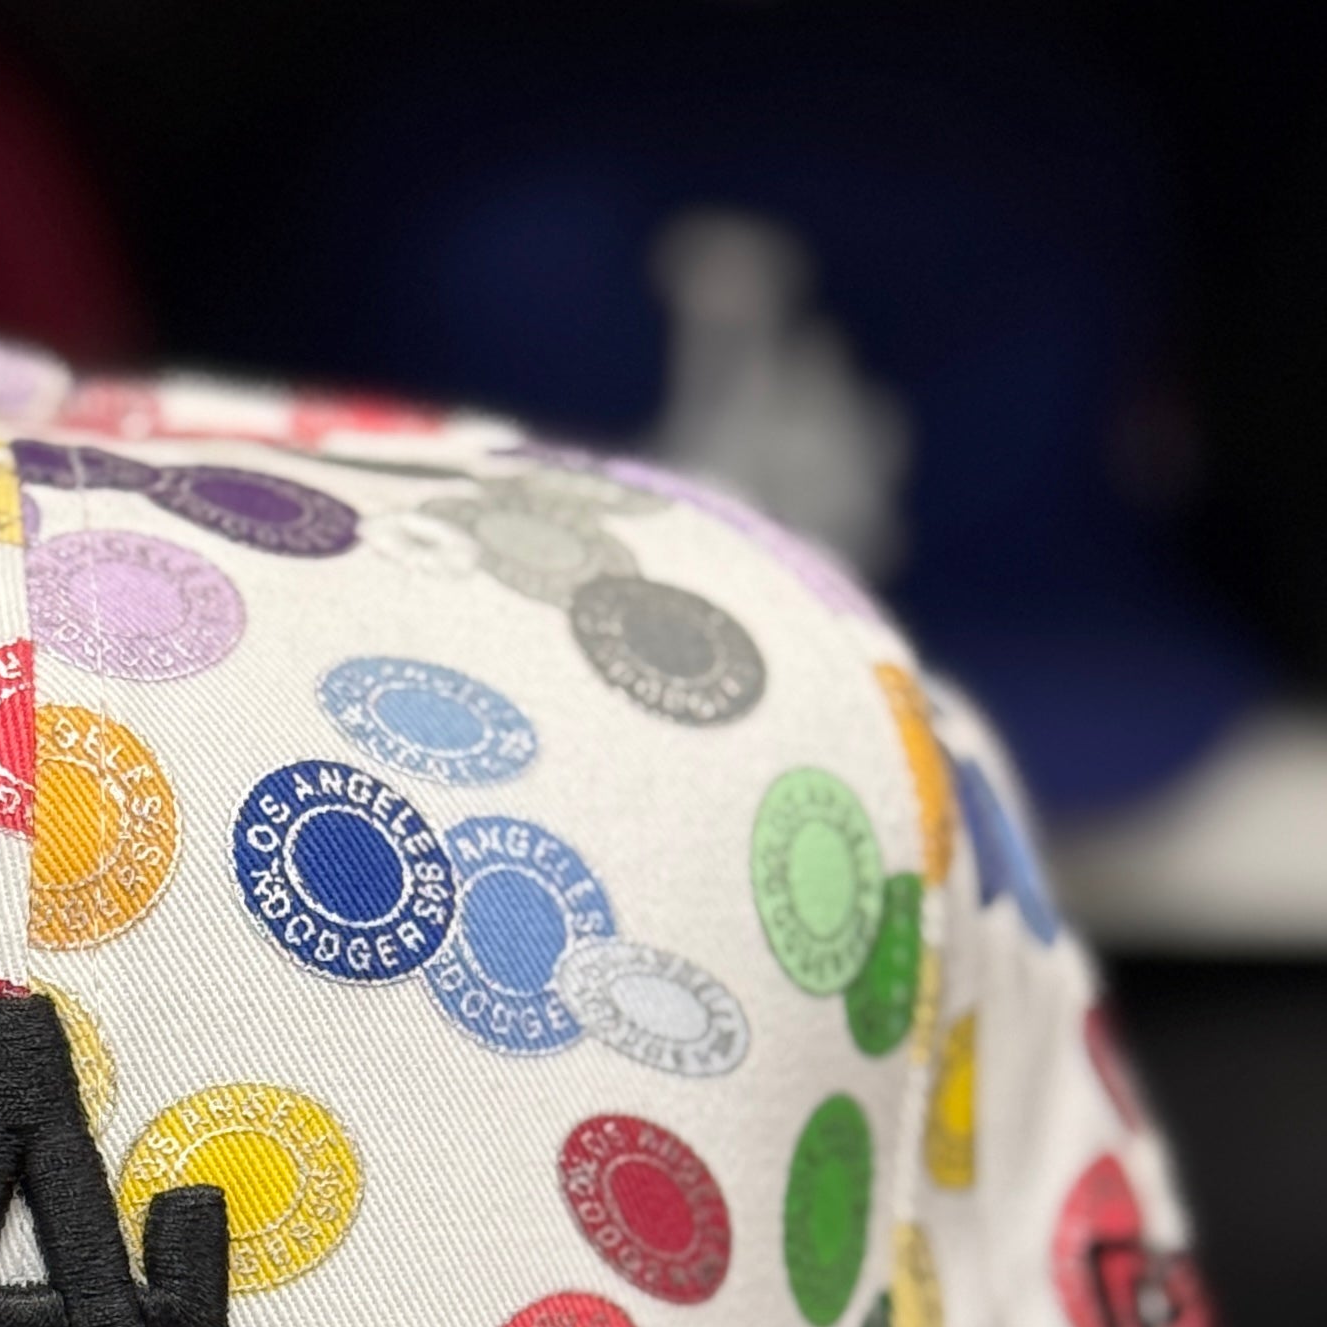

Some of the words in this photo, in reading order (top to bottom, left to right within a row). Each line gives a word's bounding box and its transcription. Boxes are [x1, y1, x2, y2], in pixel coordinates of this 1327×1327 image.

[293, 767, 445, 882] ANGELES
[260, 890, 446, 972] DODGERS
[437, 965, 572, 1040] DODGE
